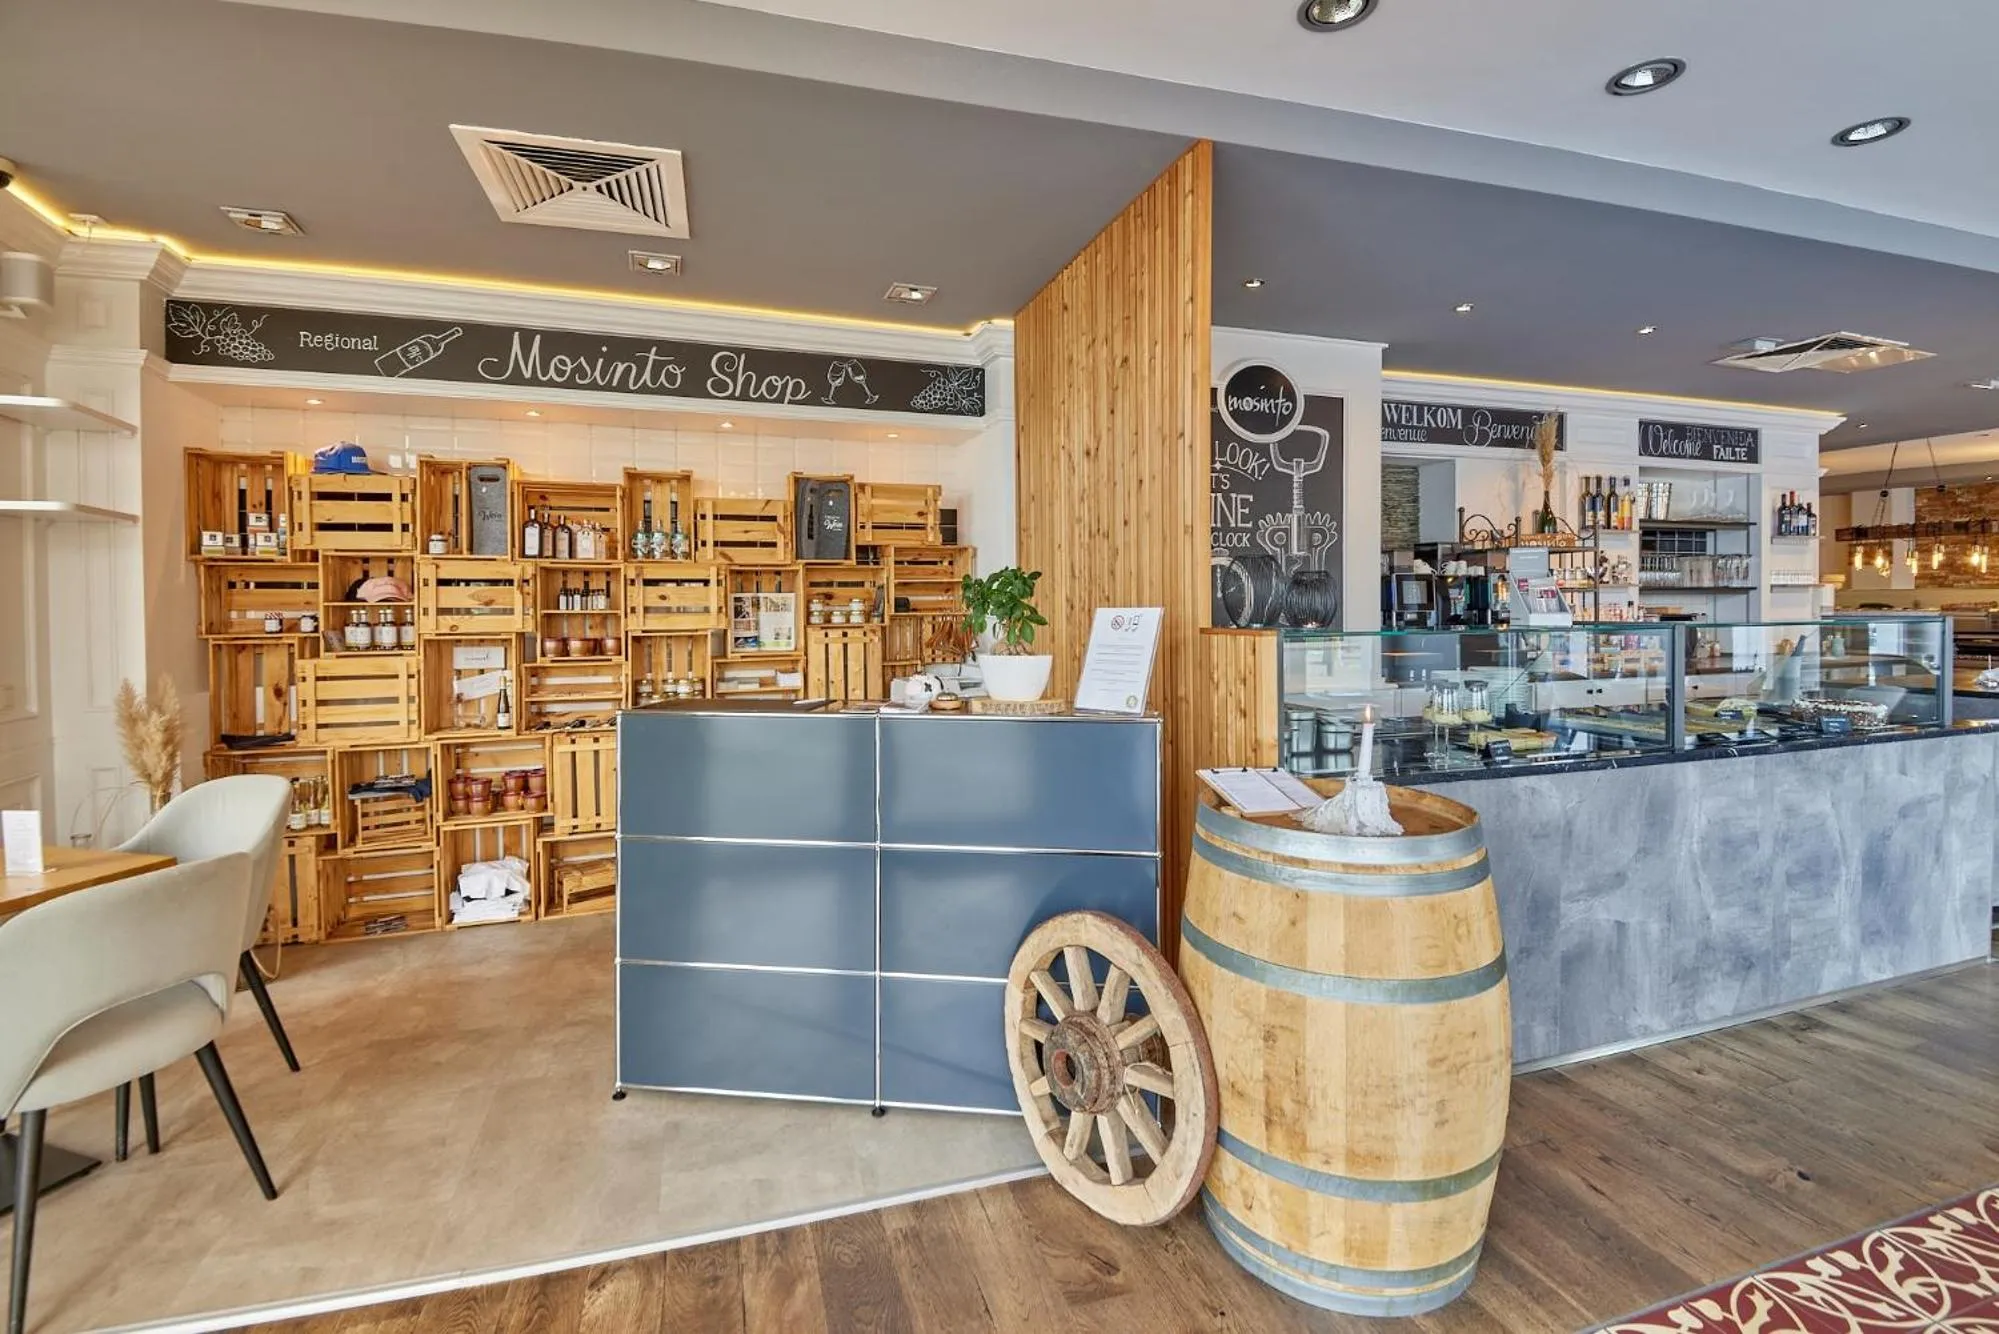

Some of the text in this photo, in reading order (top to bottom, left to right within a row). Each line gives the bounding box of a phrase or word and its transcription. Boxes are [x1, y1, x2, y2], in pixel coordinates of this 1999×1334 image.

[299, 331, 379, 352] Regional
[477, 331, 811, 404] Mosinto Shop
[1228, 385, 1293, 427] mosinto
[1383, 403, 1463, 430] WELKOM
[1640, 424, 1703, 458] Welcome
[1215, 440, 1270, 481] LOOK!
